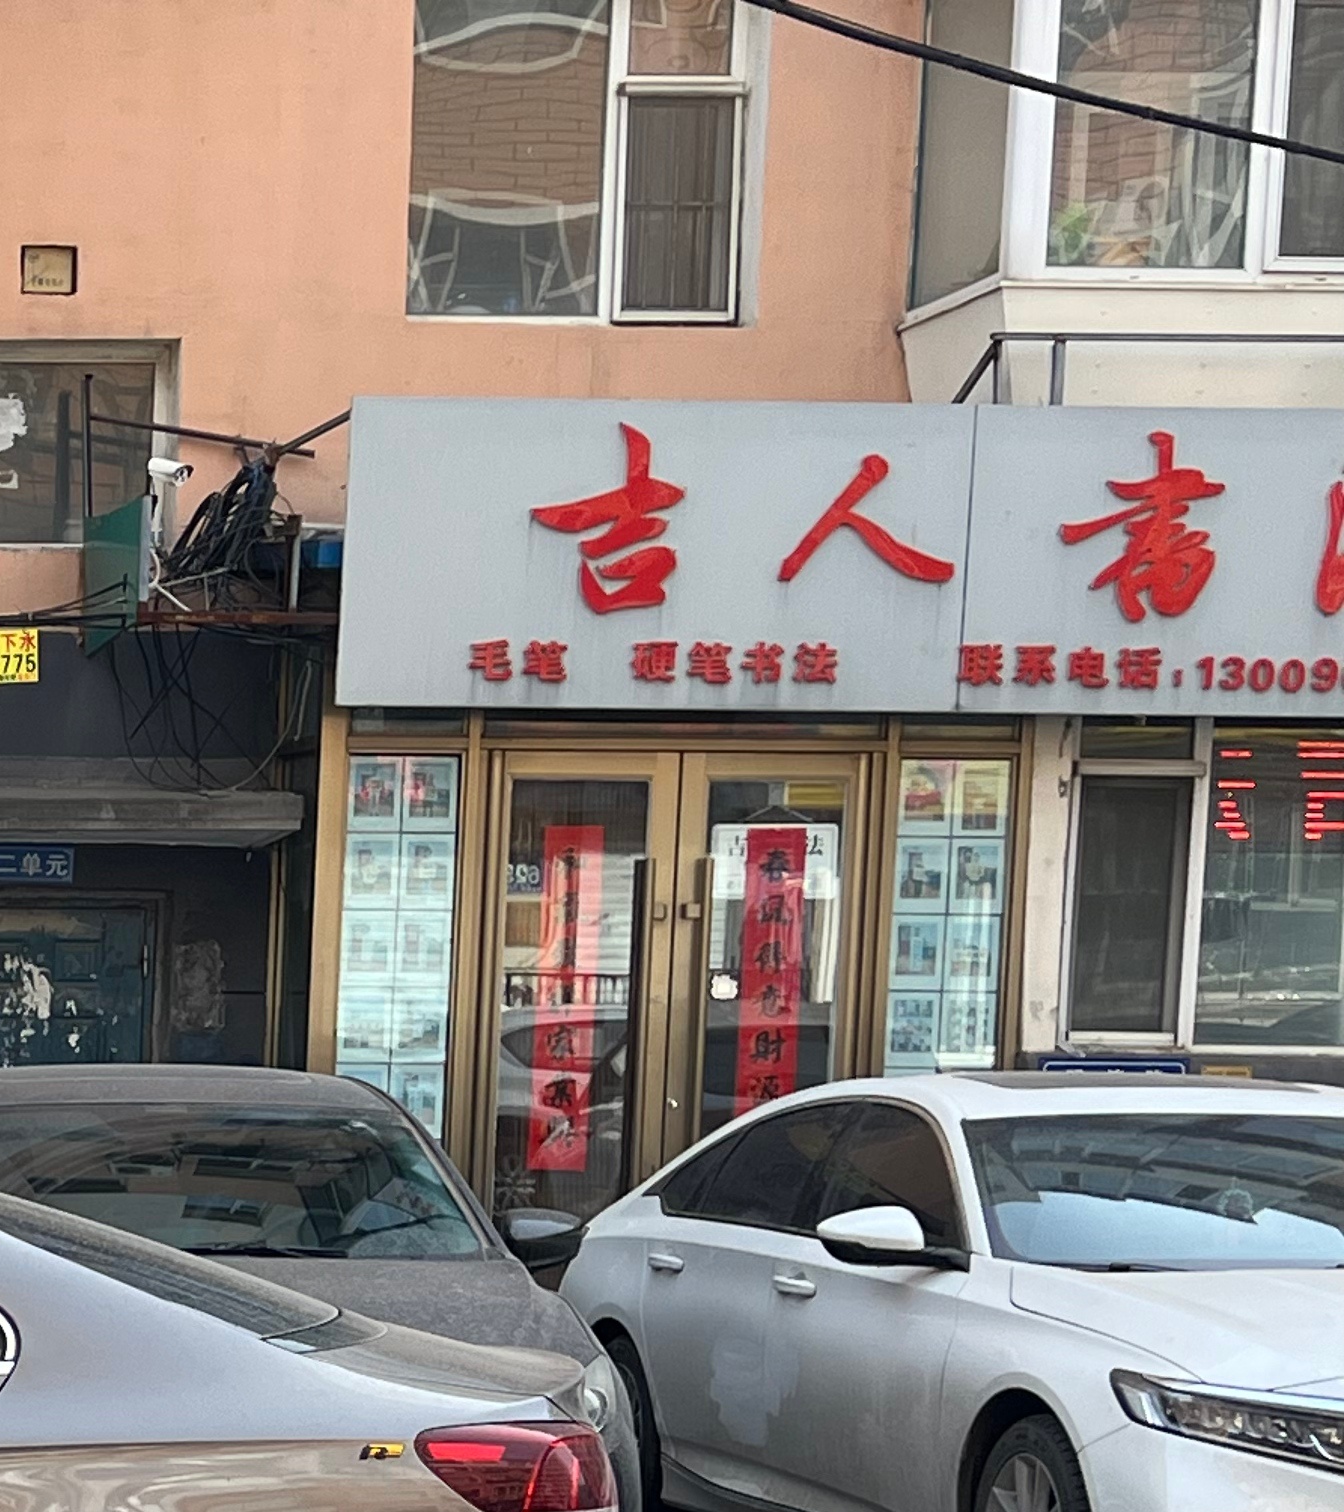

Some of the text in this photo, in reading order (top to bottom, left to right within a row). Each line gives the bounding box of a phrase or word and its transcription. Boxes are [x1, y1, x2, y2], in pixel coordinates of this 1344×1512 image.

[468, 639, 840, 684] 毛笔 硬笔书法
